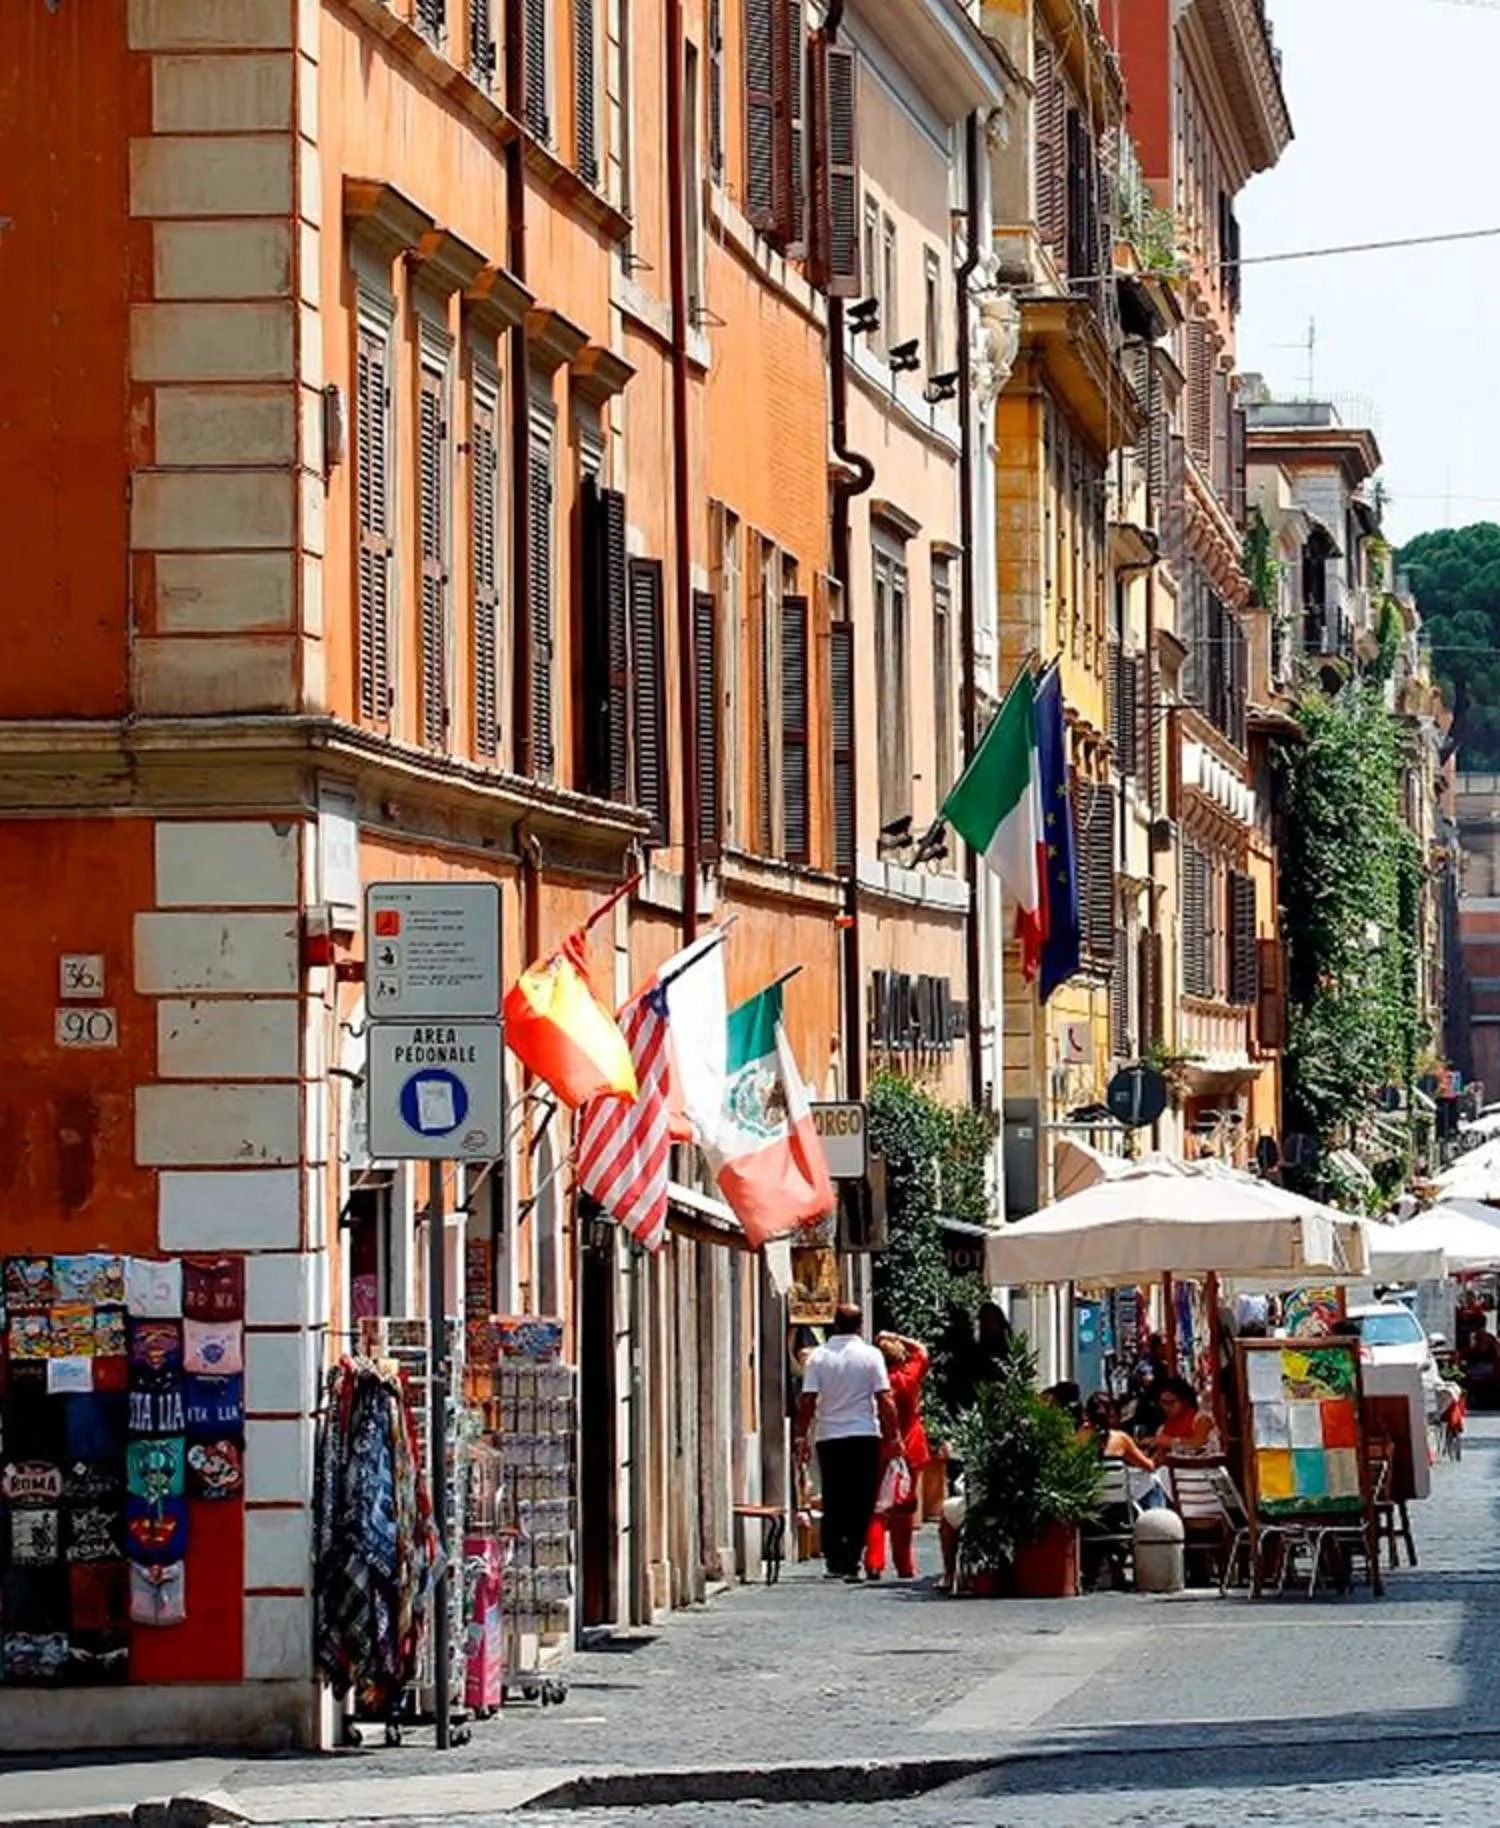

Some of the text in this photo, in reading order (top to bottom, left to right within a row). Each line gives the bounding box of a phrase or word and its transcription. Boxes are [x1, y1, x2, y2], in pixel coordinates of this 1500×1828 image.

[64, 1012, 112, 1042] 90
[413, 1028, 455, 1044] AREA
[395, 1045, 475, 1062] PEDONALE
[812, 1110, 860, 1136] ORGO
[10, 1475, 57, 1492] ROMA
